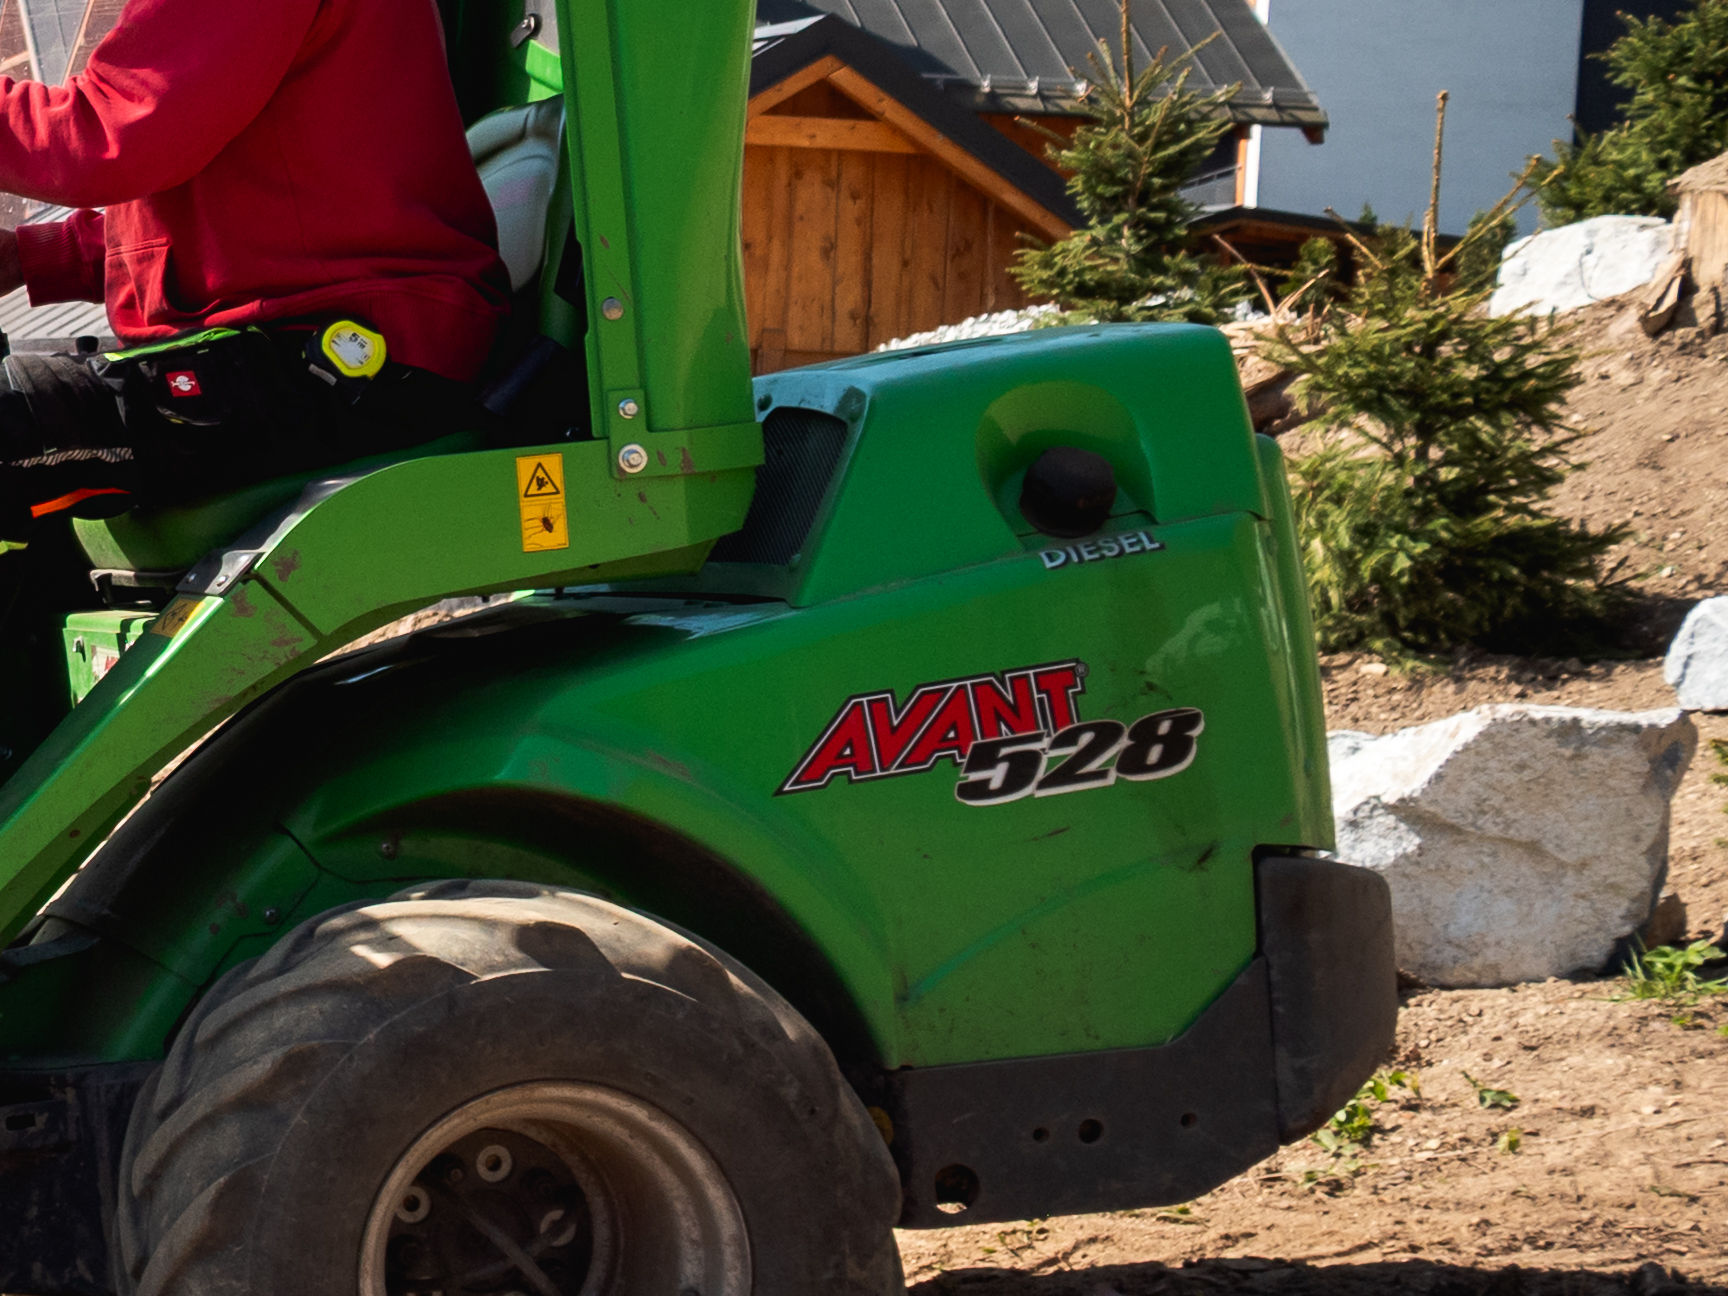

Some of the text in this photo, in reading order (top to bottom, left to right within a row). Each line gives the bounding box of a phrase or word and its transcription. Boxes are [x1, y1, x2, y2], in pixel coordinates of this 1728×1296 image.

[1039, 531, 1162, 569] DIESEL
[779, 659, 1084, 794] AVANT
[955, 706, 1205, 806] 528
